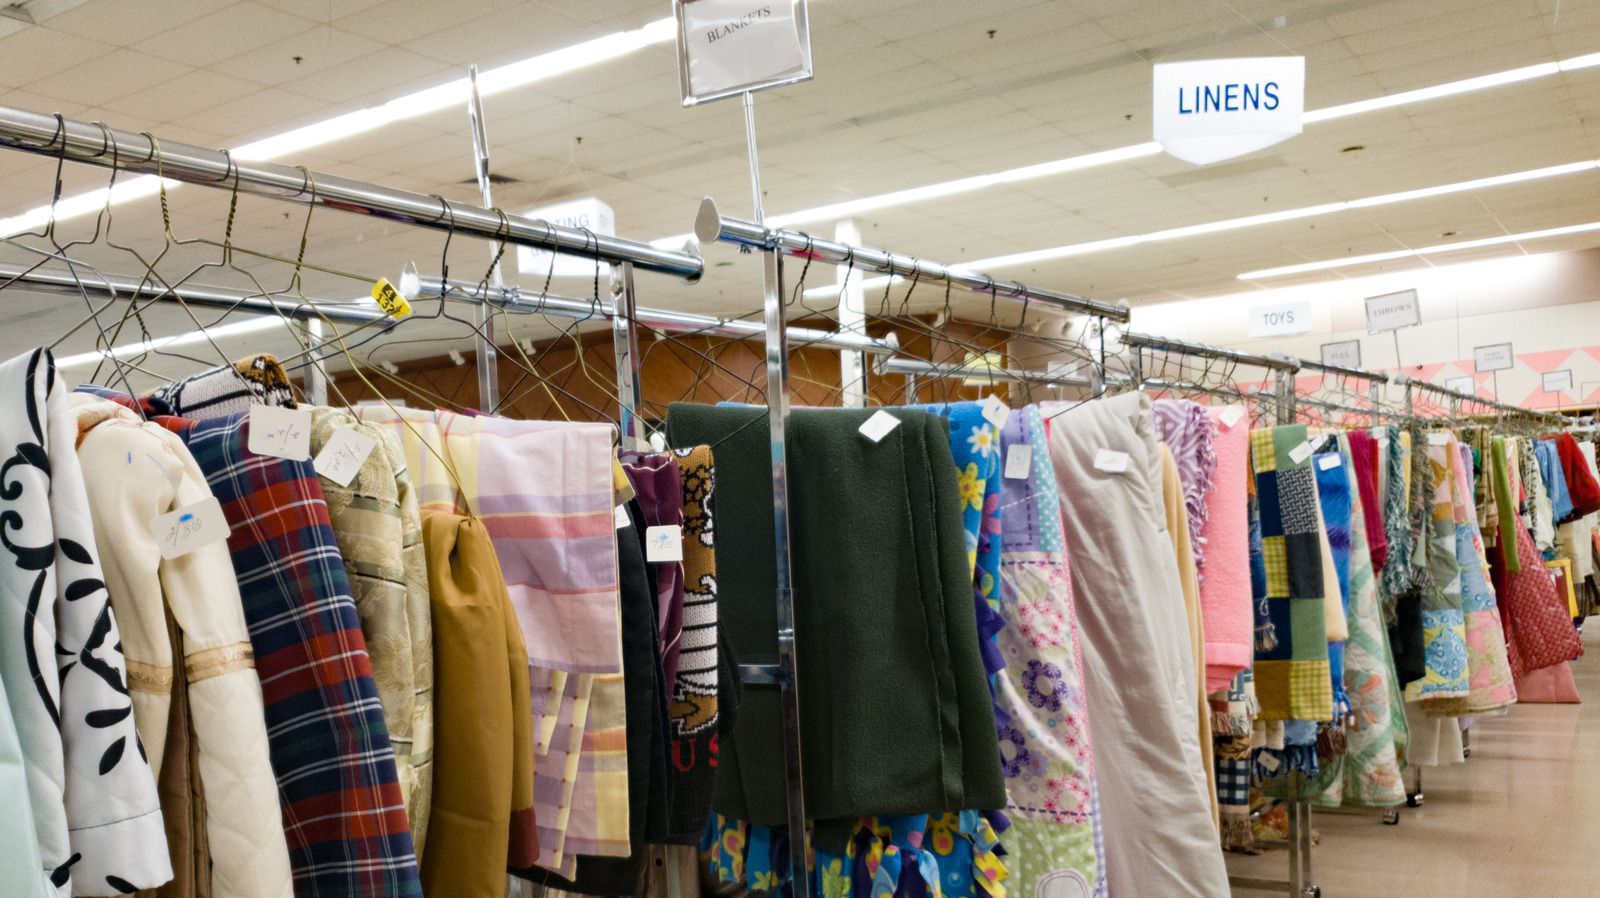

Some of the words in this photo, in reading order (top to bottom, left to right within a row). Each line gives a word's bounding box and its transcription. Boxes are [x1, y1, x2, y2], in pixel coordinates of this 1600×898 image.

[707, 5, 771, 44] BLANKETS
[1178, 81, 1280, 115] LINENS
[1262, 310, 1295, 327] TOYS
[1373, 302, 1412, 317] THROWS
